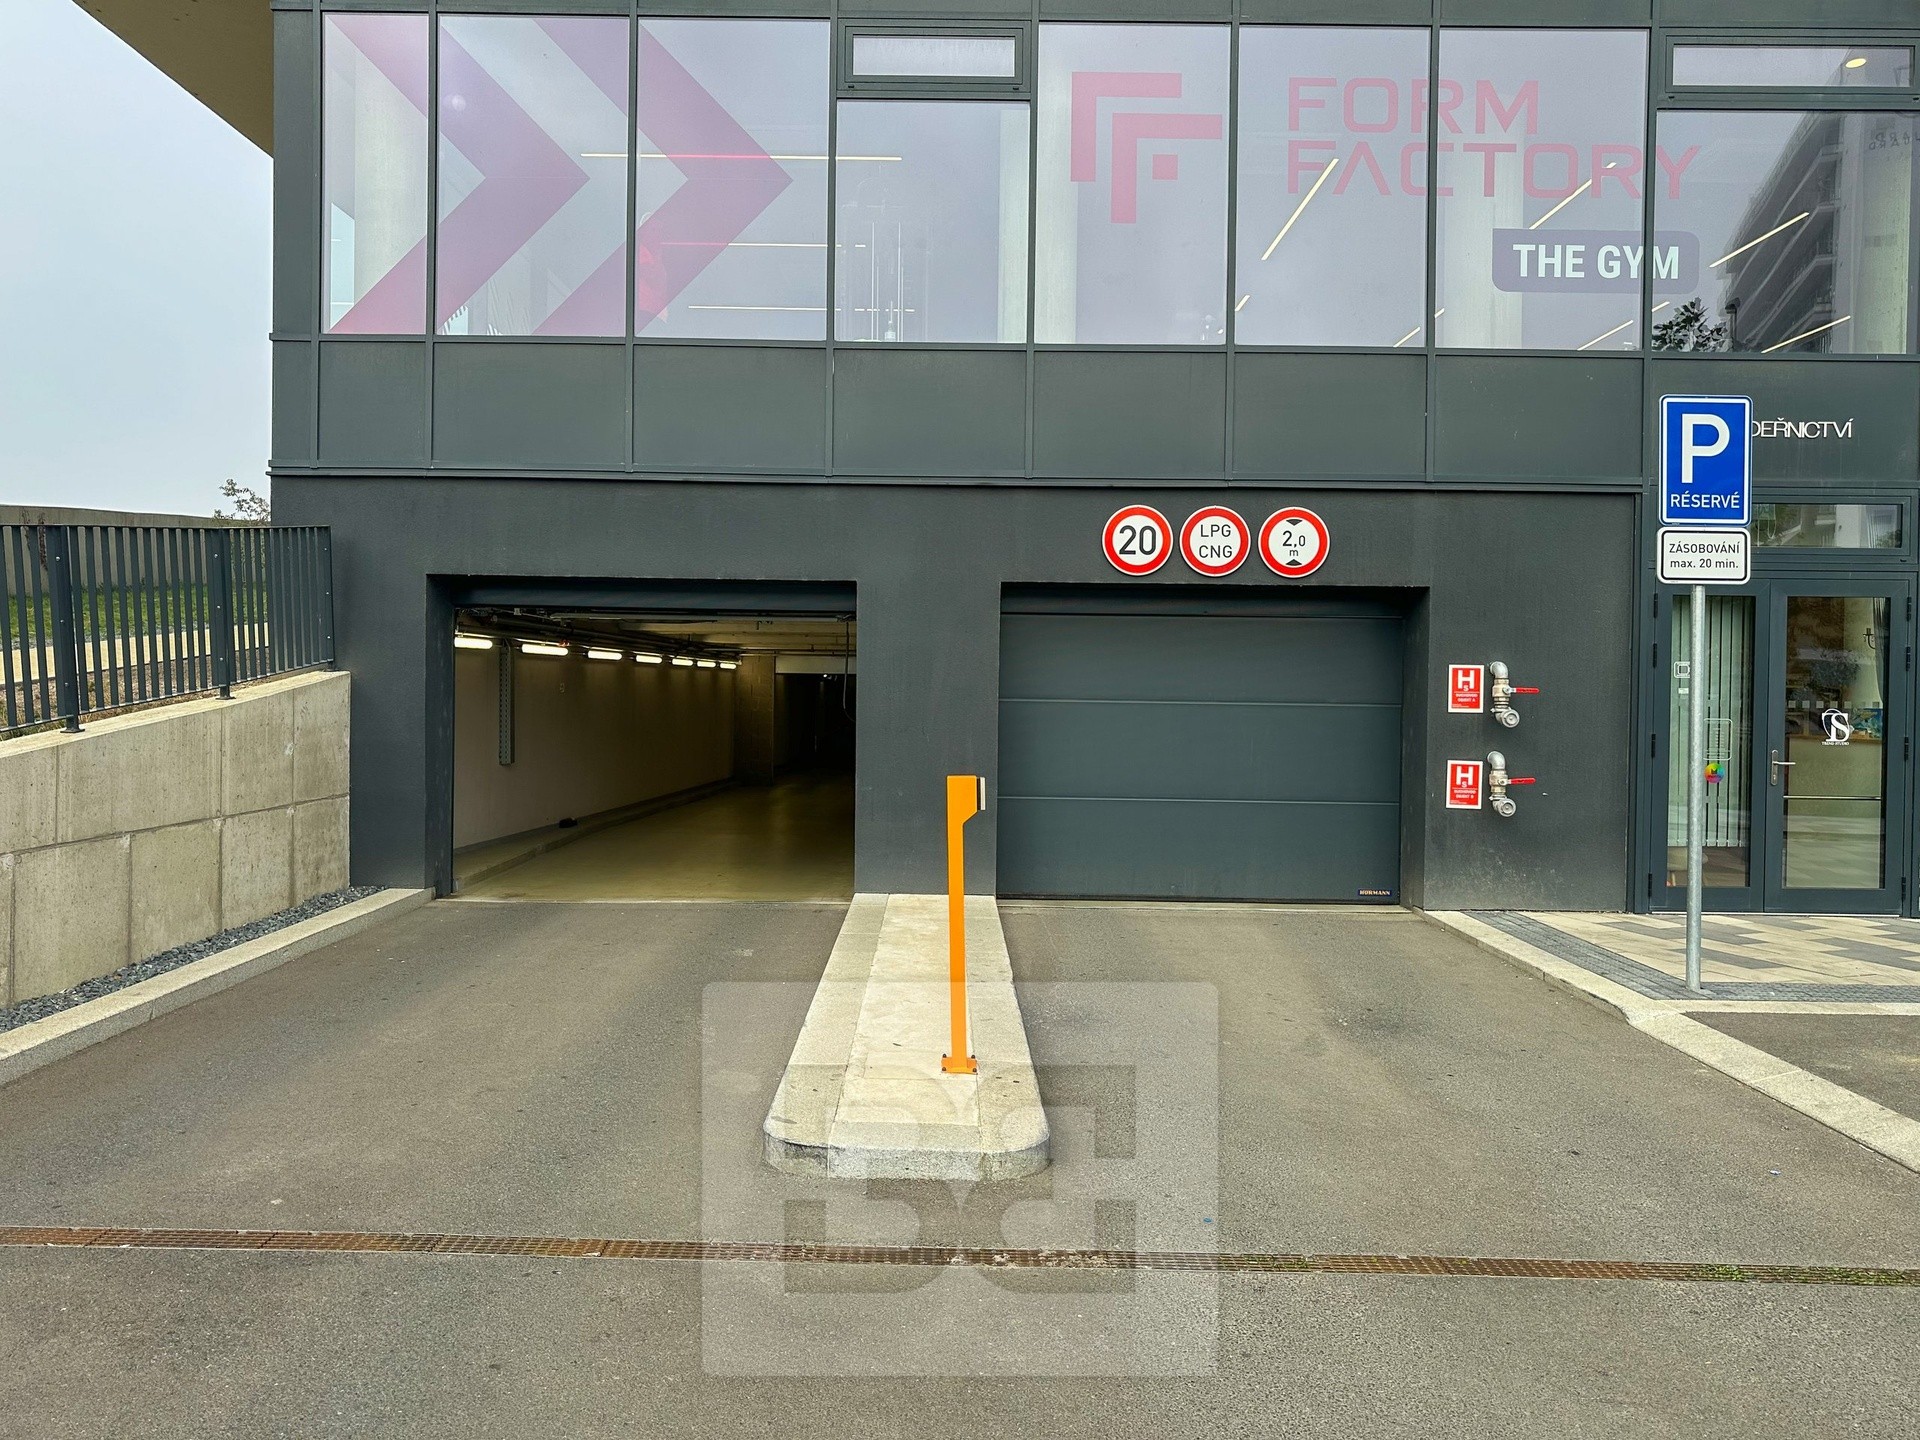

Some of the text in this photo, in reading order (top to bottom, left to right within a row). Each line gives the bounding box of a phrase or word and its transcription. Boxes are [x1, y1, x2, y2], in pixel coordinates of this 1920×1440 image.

[1288, 77, 1540, 135] FORM
[1287, 140, 1701, 199] FACTORY
[1513, 244, 1680, 280] THE GYM
[1681, 413, 1730, 483] P
[1670, 491, 1740, 509] RÉSERVÉ
[1118, 525, 1157, 555] 20
[1200, 524, 1231, 537] LPG
[1282, 530, 1306, 548] 2,0
[1199, 545, 1232, 559] CNG
[1289, 549, 1299, 557] m
[1669, 540, 1740, 554] ZÁSOBOVÁNÍ
[1670, 558, 1739, 568] max. 20 min.
[1457, 669, 1475, 689] H
[1456, 765, 1474, 786] H
